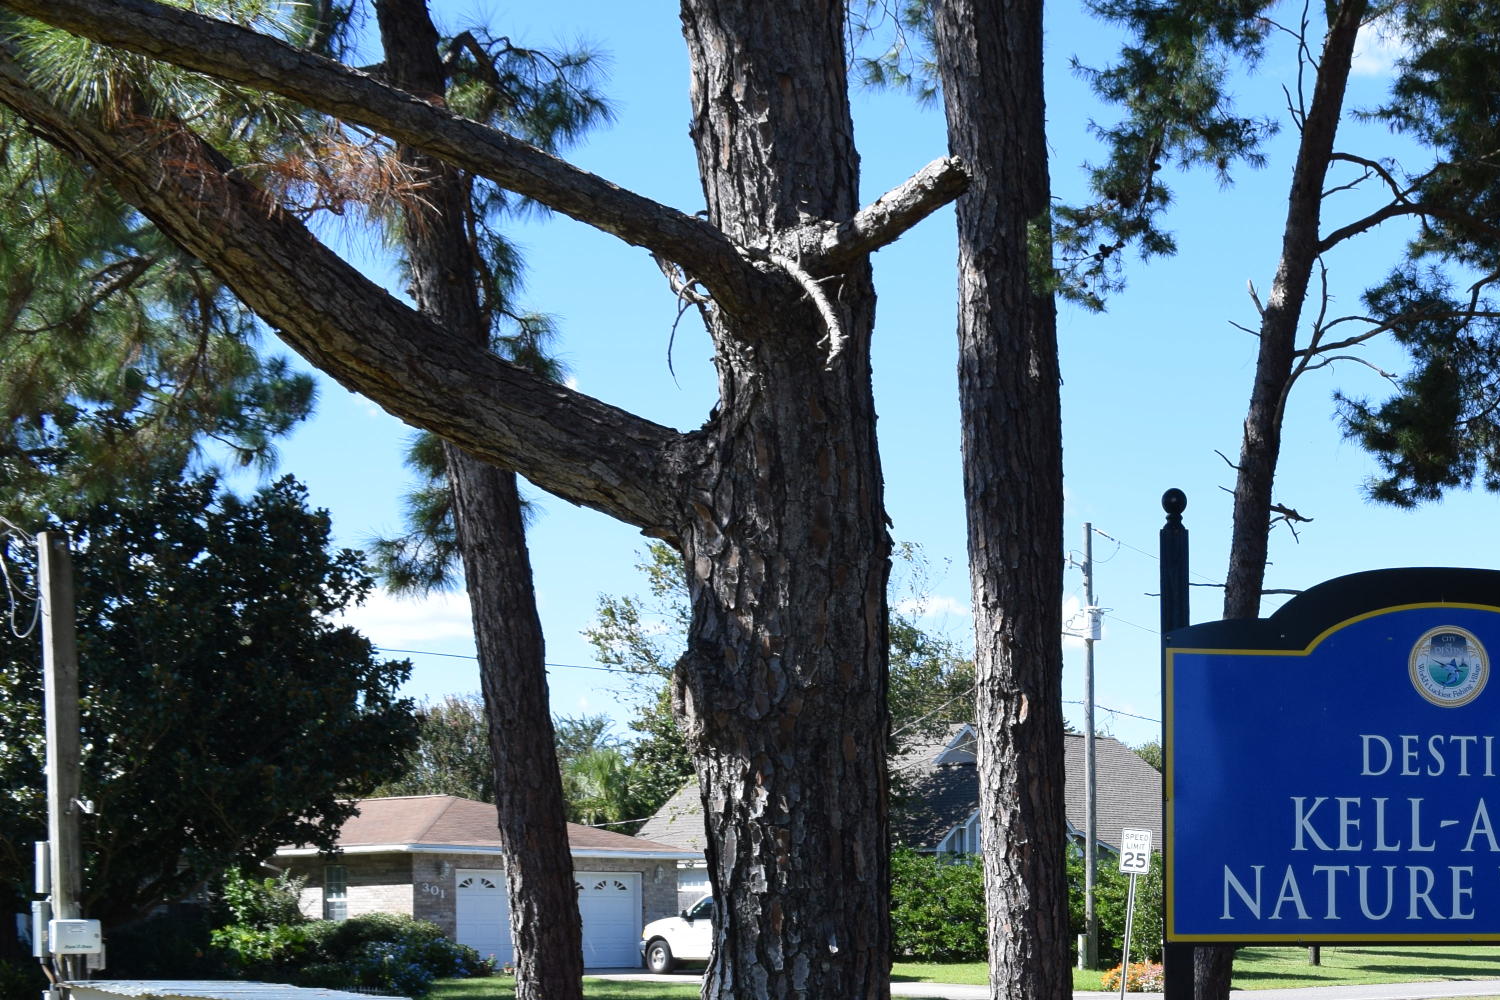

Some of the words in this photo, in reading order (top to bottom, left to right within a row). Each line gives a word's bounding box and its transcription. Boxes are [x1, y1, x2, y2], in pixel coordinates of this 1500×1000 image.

[1125, 833, 1149, 841] SPEED
[1126, 842, 1145, 850] LIMIT
[1123, 851, 1146, 868] 25
[422, 882, 445, 899] 301
[1219, 864, 1476, 921] NATURE
